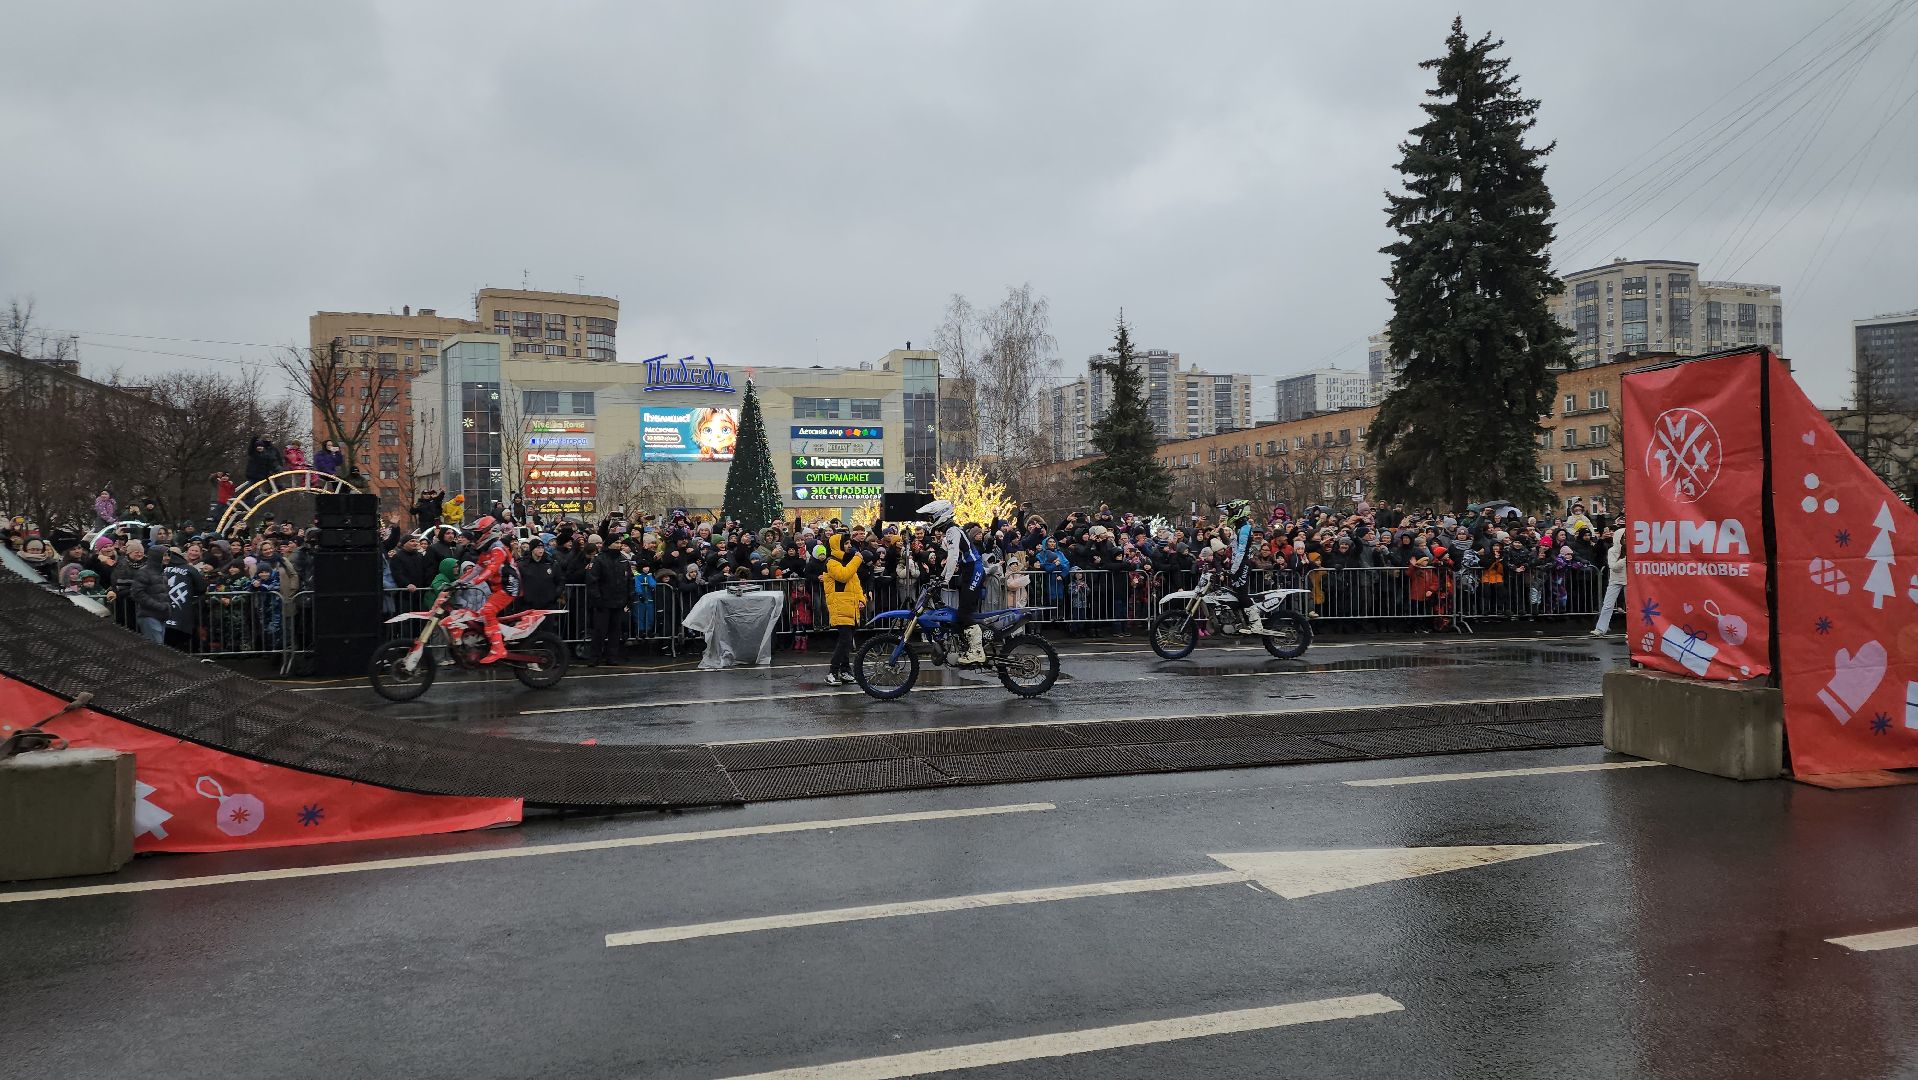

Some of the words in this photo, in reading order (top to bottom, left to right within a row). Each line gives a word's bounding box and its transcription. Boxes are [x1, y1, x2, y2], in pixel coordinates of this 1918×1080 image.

[643, 354, 731, 386] Победа
[828, 429, 844, 437] мир
[527, 453, 556, 462] DNS
[810, 456, 881, 469] Перекресток
[806, 473, 870, 482] СУПЕРМАРКЕТ
[530, 486, 590, 495] ХОЗМАКС
[1633, 518, 1750, 554] ЗИМА
[1642, 562, 1751, 577] ПОДМОСКОВЬЕ
